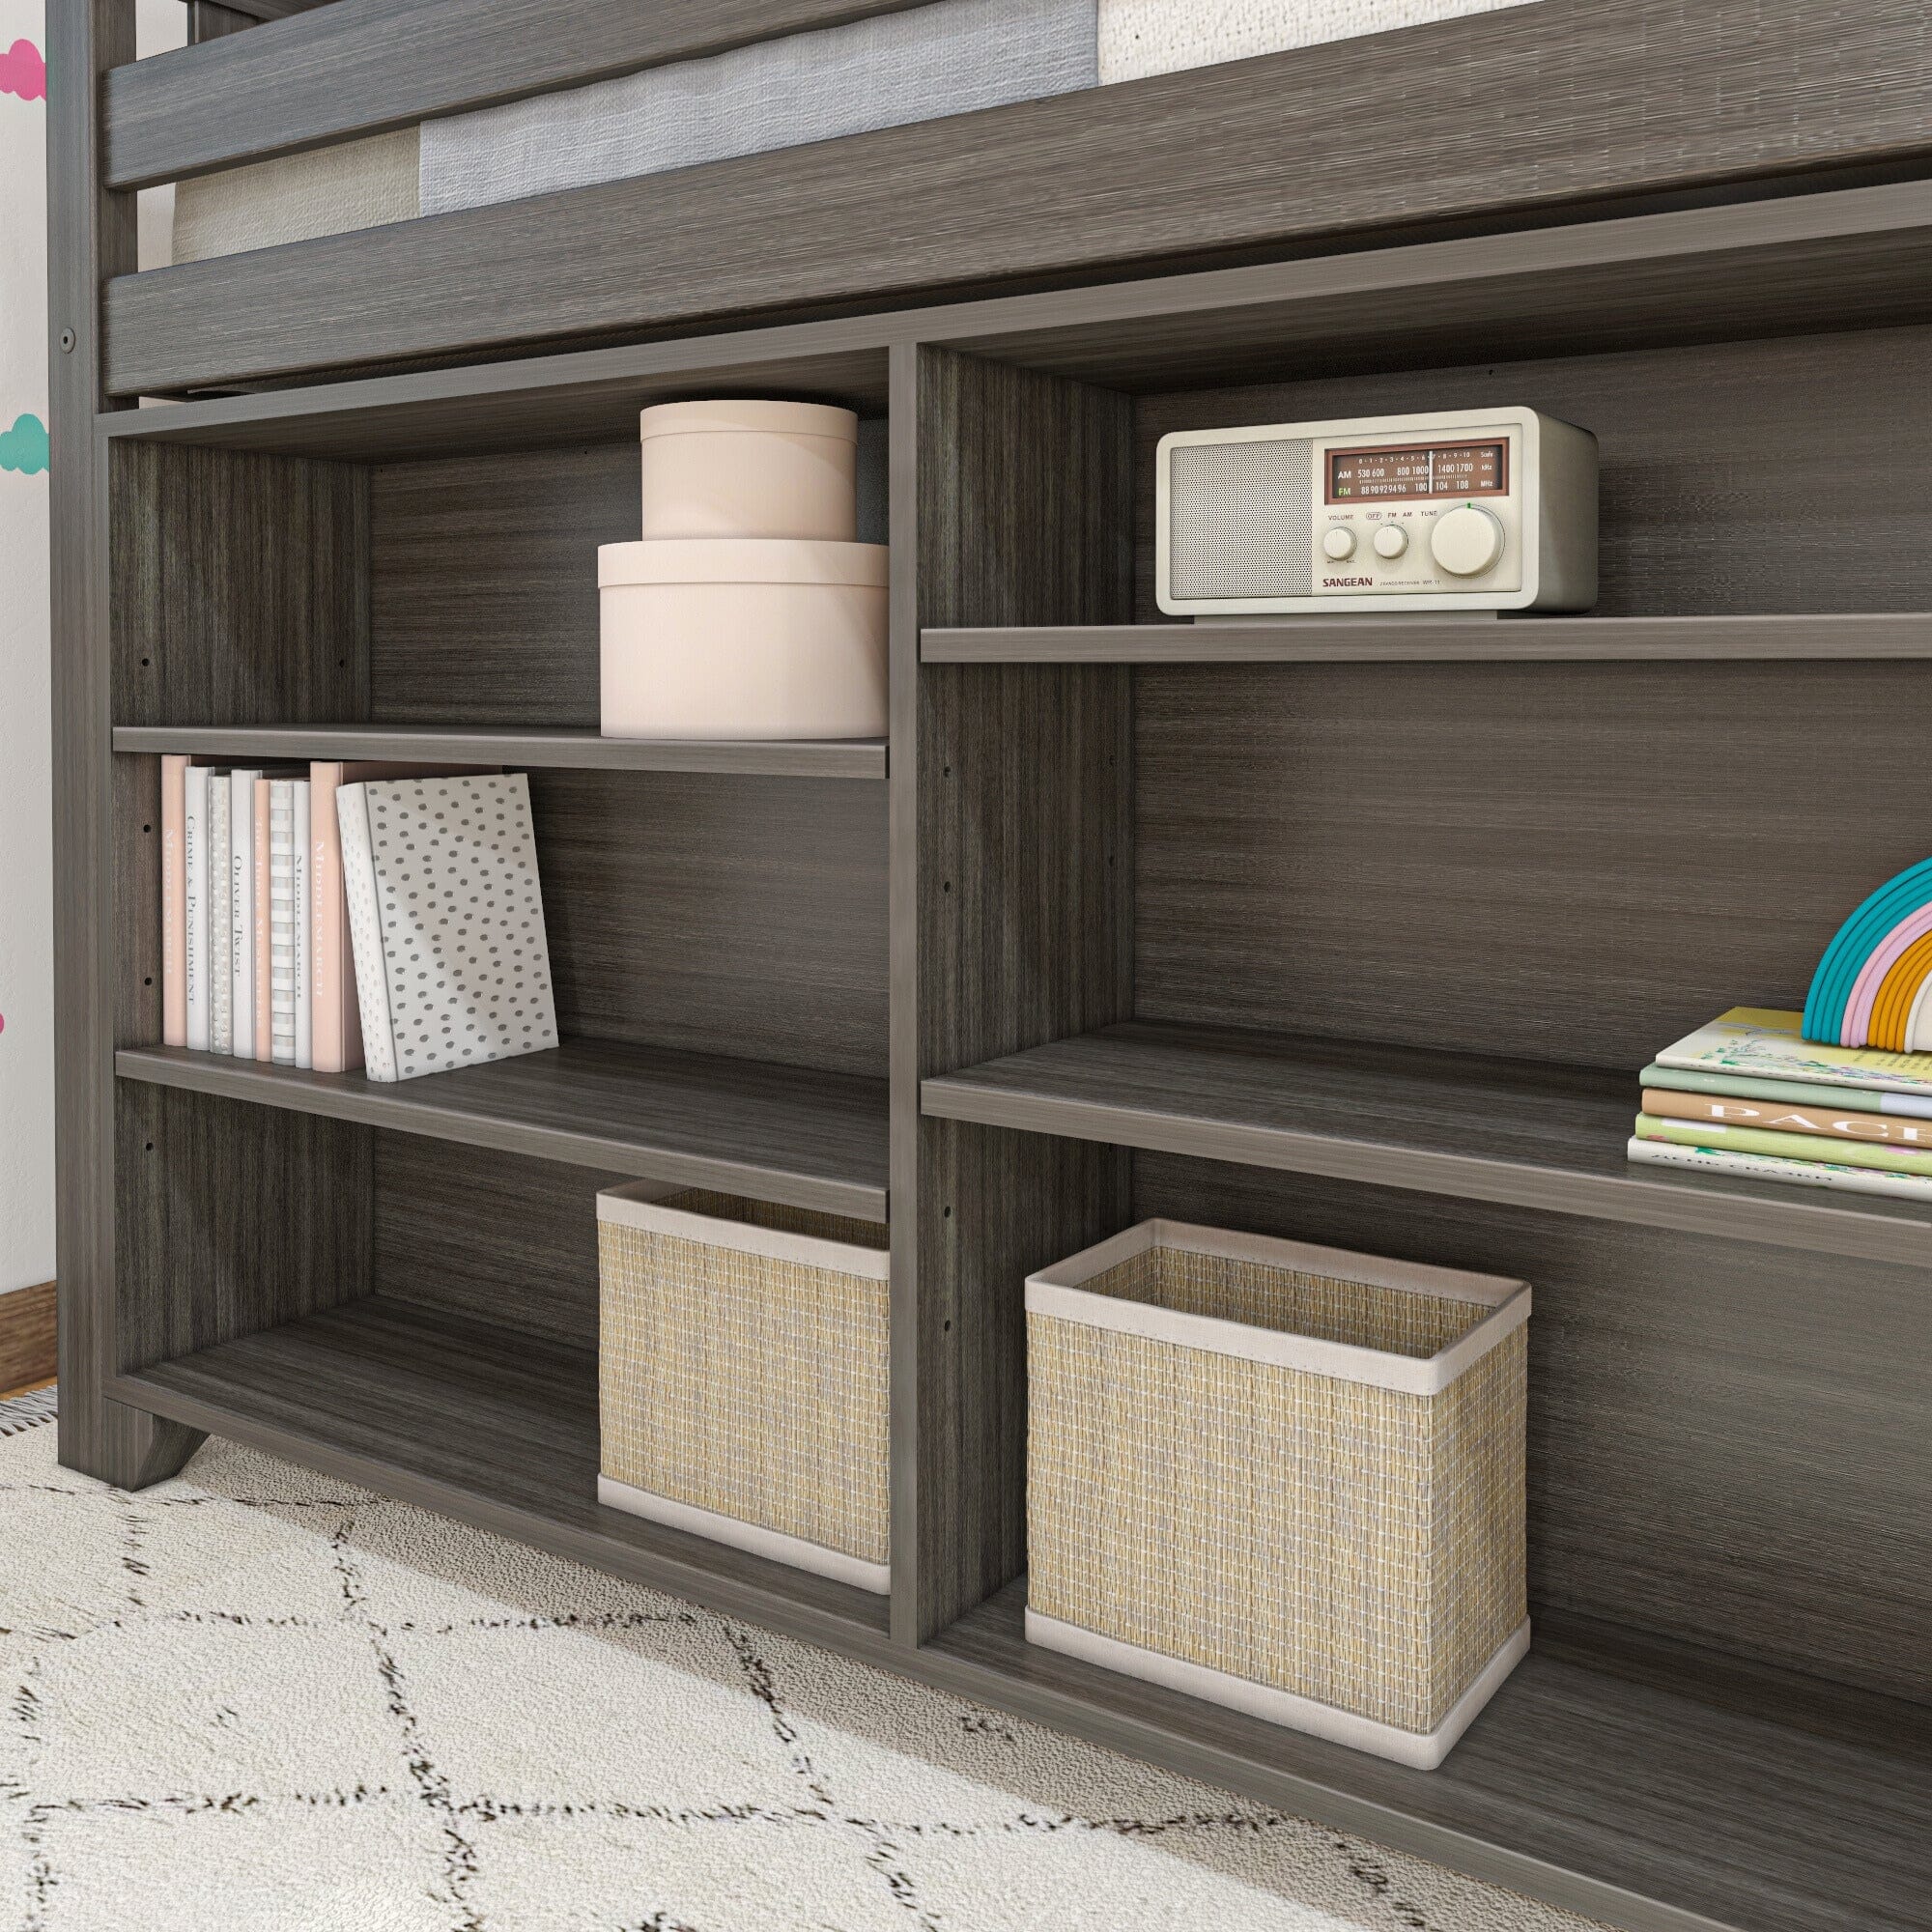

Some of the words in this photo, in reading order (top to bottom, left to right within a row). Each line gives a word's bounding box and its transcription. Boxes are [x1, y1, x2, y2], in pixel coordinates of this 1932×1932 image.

[1337, 470, 1351, 479] AM
[1357, 469, 1371, 478] 530
[1372, 468, 1385, 477] 600
[1397, 467, 1409, 476] 800
[1412, 465, 1429, 475] 1000
[1437, 464, 1455, 473] 1400
[1457, 463, 1473, 472] 1700
[1338, 487, 1351, 496] FM
[1415, 482, 1428, 492] 100
[1435, 481, 1448, 491] 104
[1456, 480, 1469, 490] 108
[1322, 577, 1373, 587] SANGEAN
[234, 855, 242, 919] OLIVER
[187, 896, 196, 1005] PUNISHMENT
[234, 924, 242, 978] TWIST
